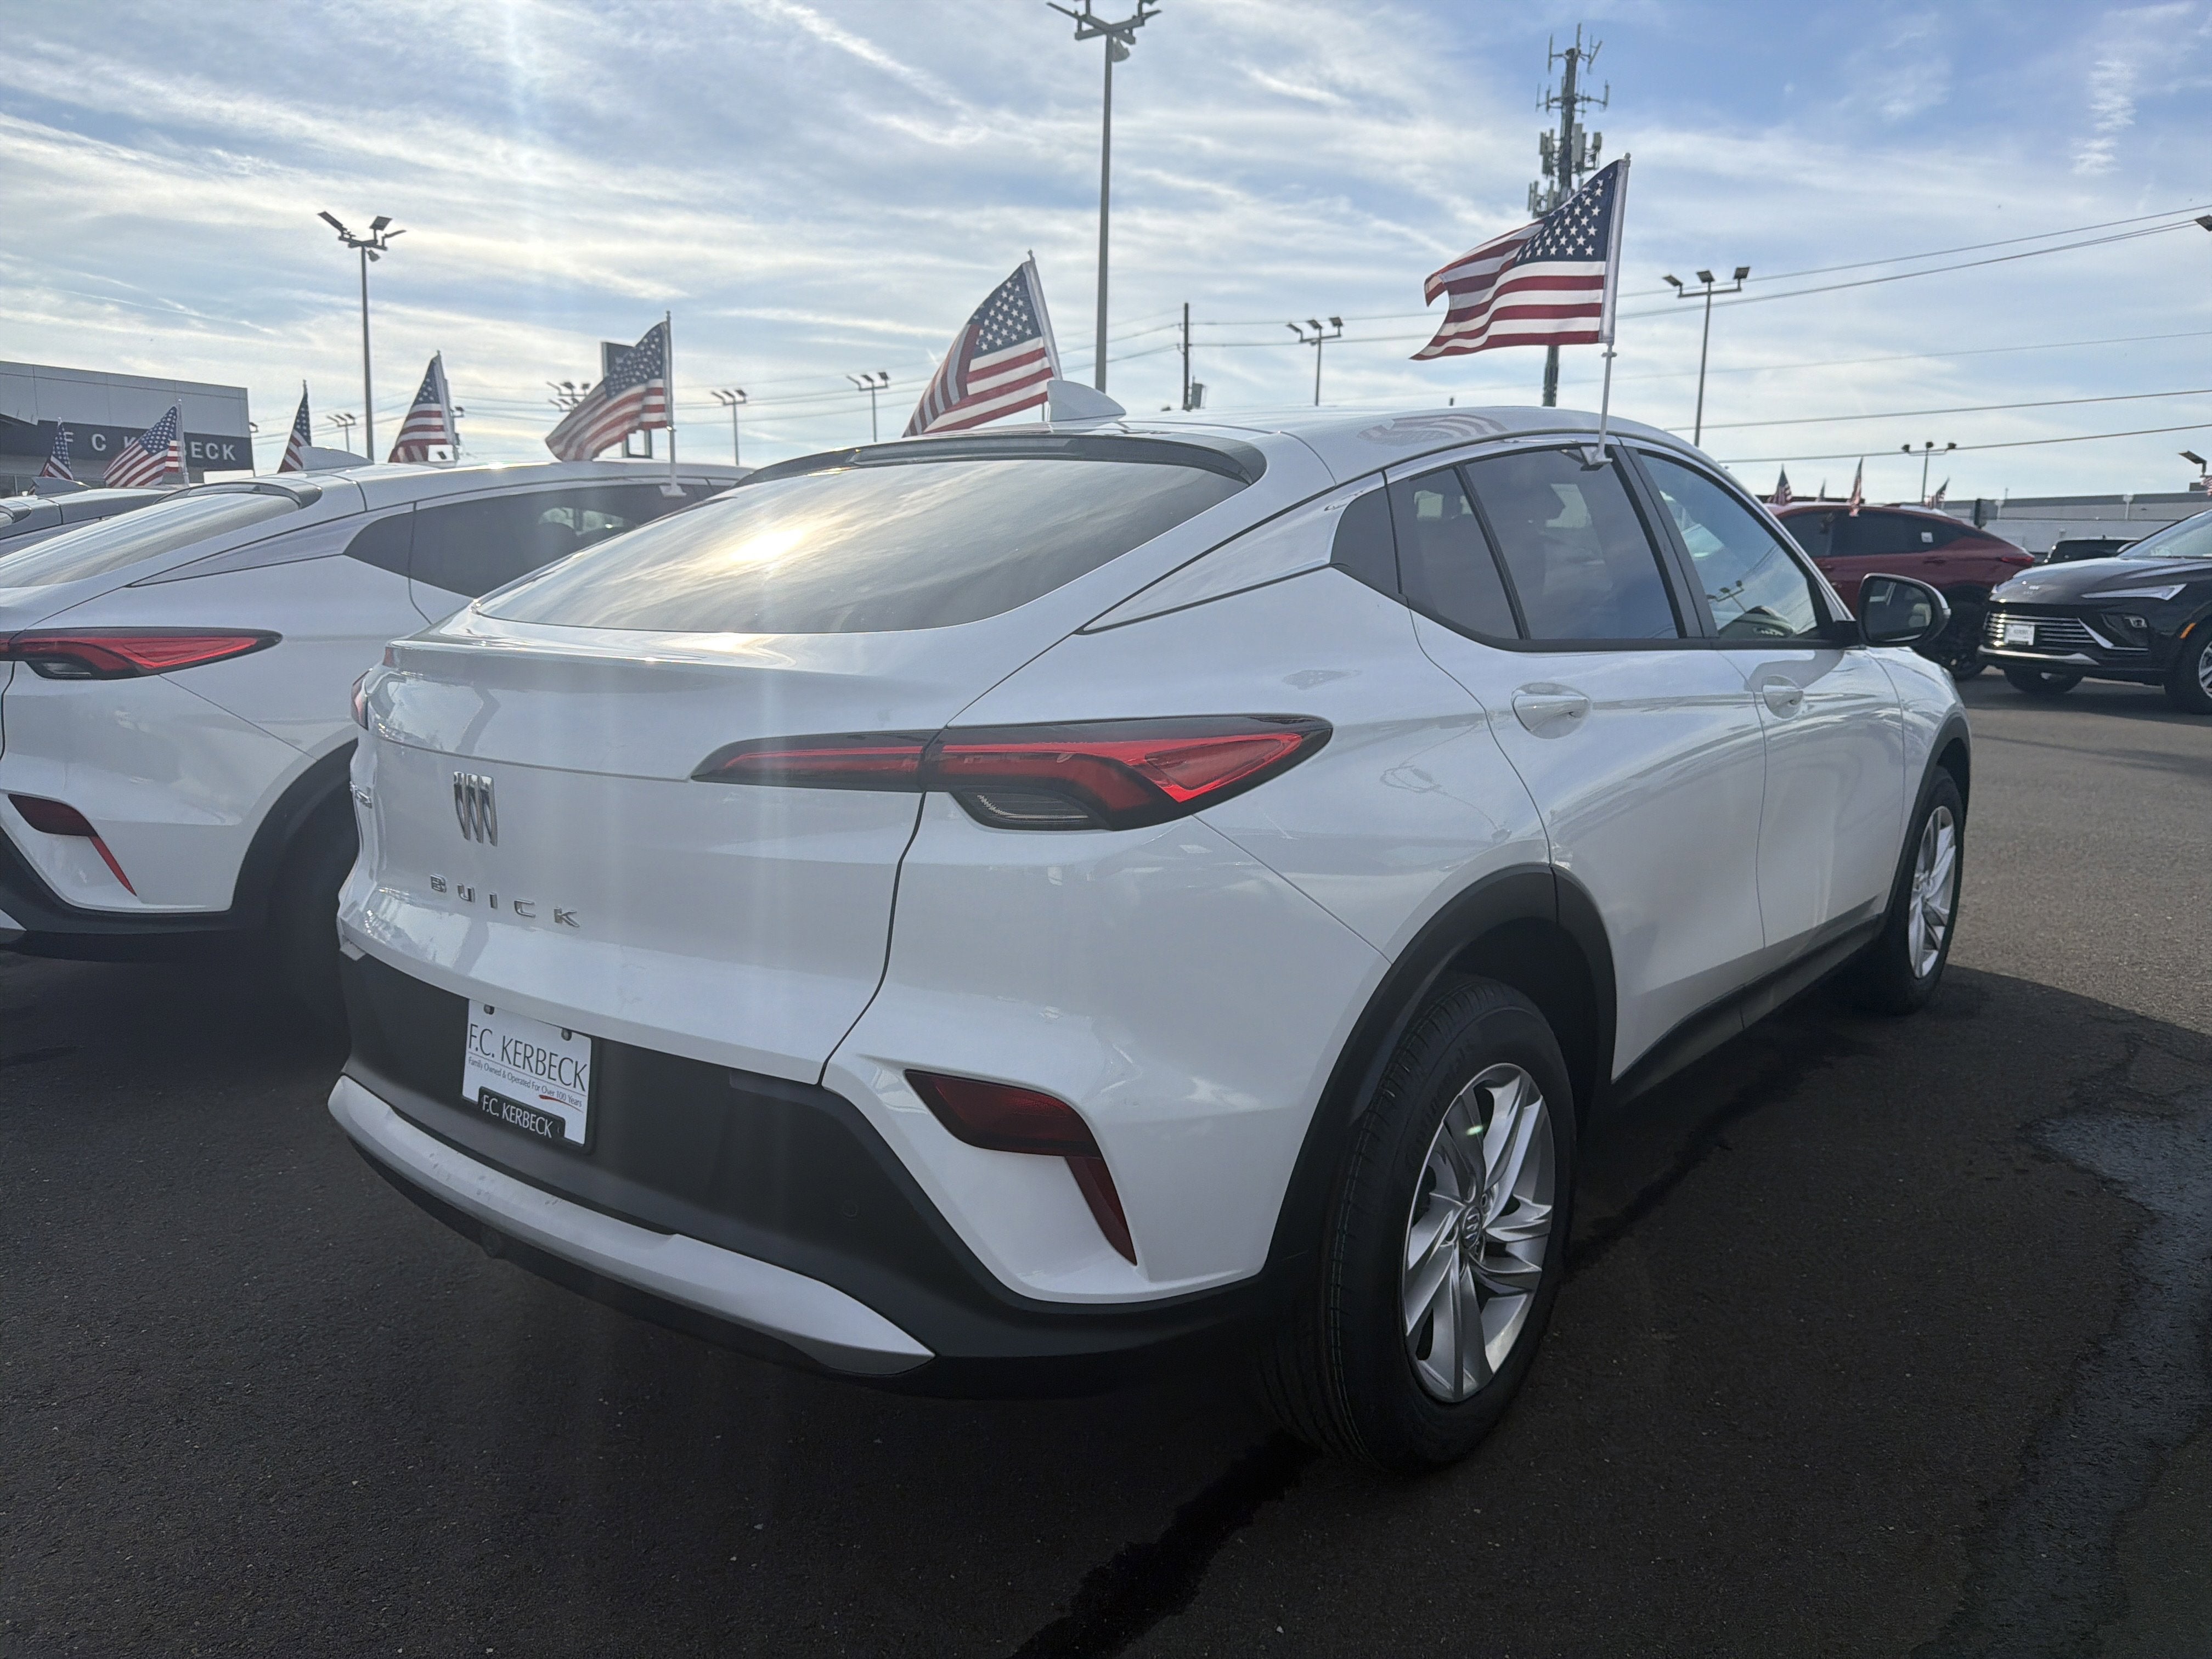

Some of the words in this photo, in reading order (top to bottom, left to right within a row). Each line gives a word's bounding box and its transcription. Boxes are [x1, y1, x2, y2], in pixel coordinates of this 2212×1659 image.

[92, 433, 106, 451] C
[430, 873, 580, 928] BUICK
[469, 1023, 495, 1058] F.C.
[501, 1035, 588, 1092] KERBECK
[469, 1057, 483, 1070] Family
[484, 1063, 502, 1076] Owned
[503, 1070, 506, 1079] &
[507, 1072, 531, 1088] Operated
[532, 1081, 541, 1092] For
[541, 1085, 555, 1097] Over
[556, 1091, 567, 1101] 100
[568, 1094, 582, 1108] Years
[482, 1094, 499, 1117] F.C.
[501, 1102, 554, 1138] KERBECK
